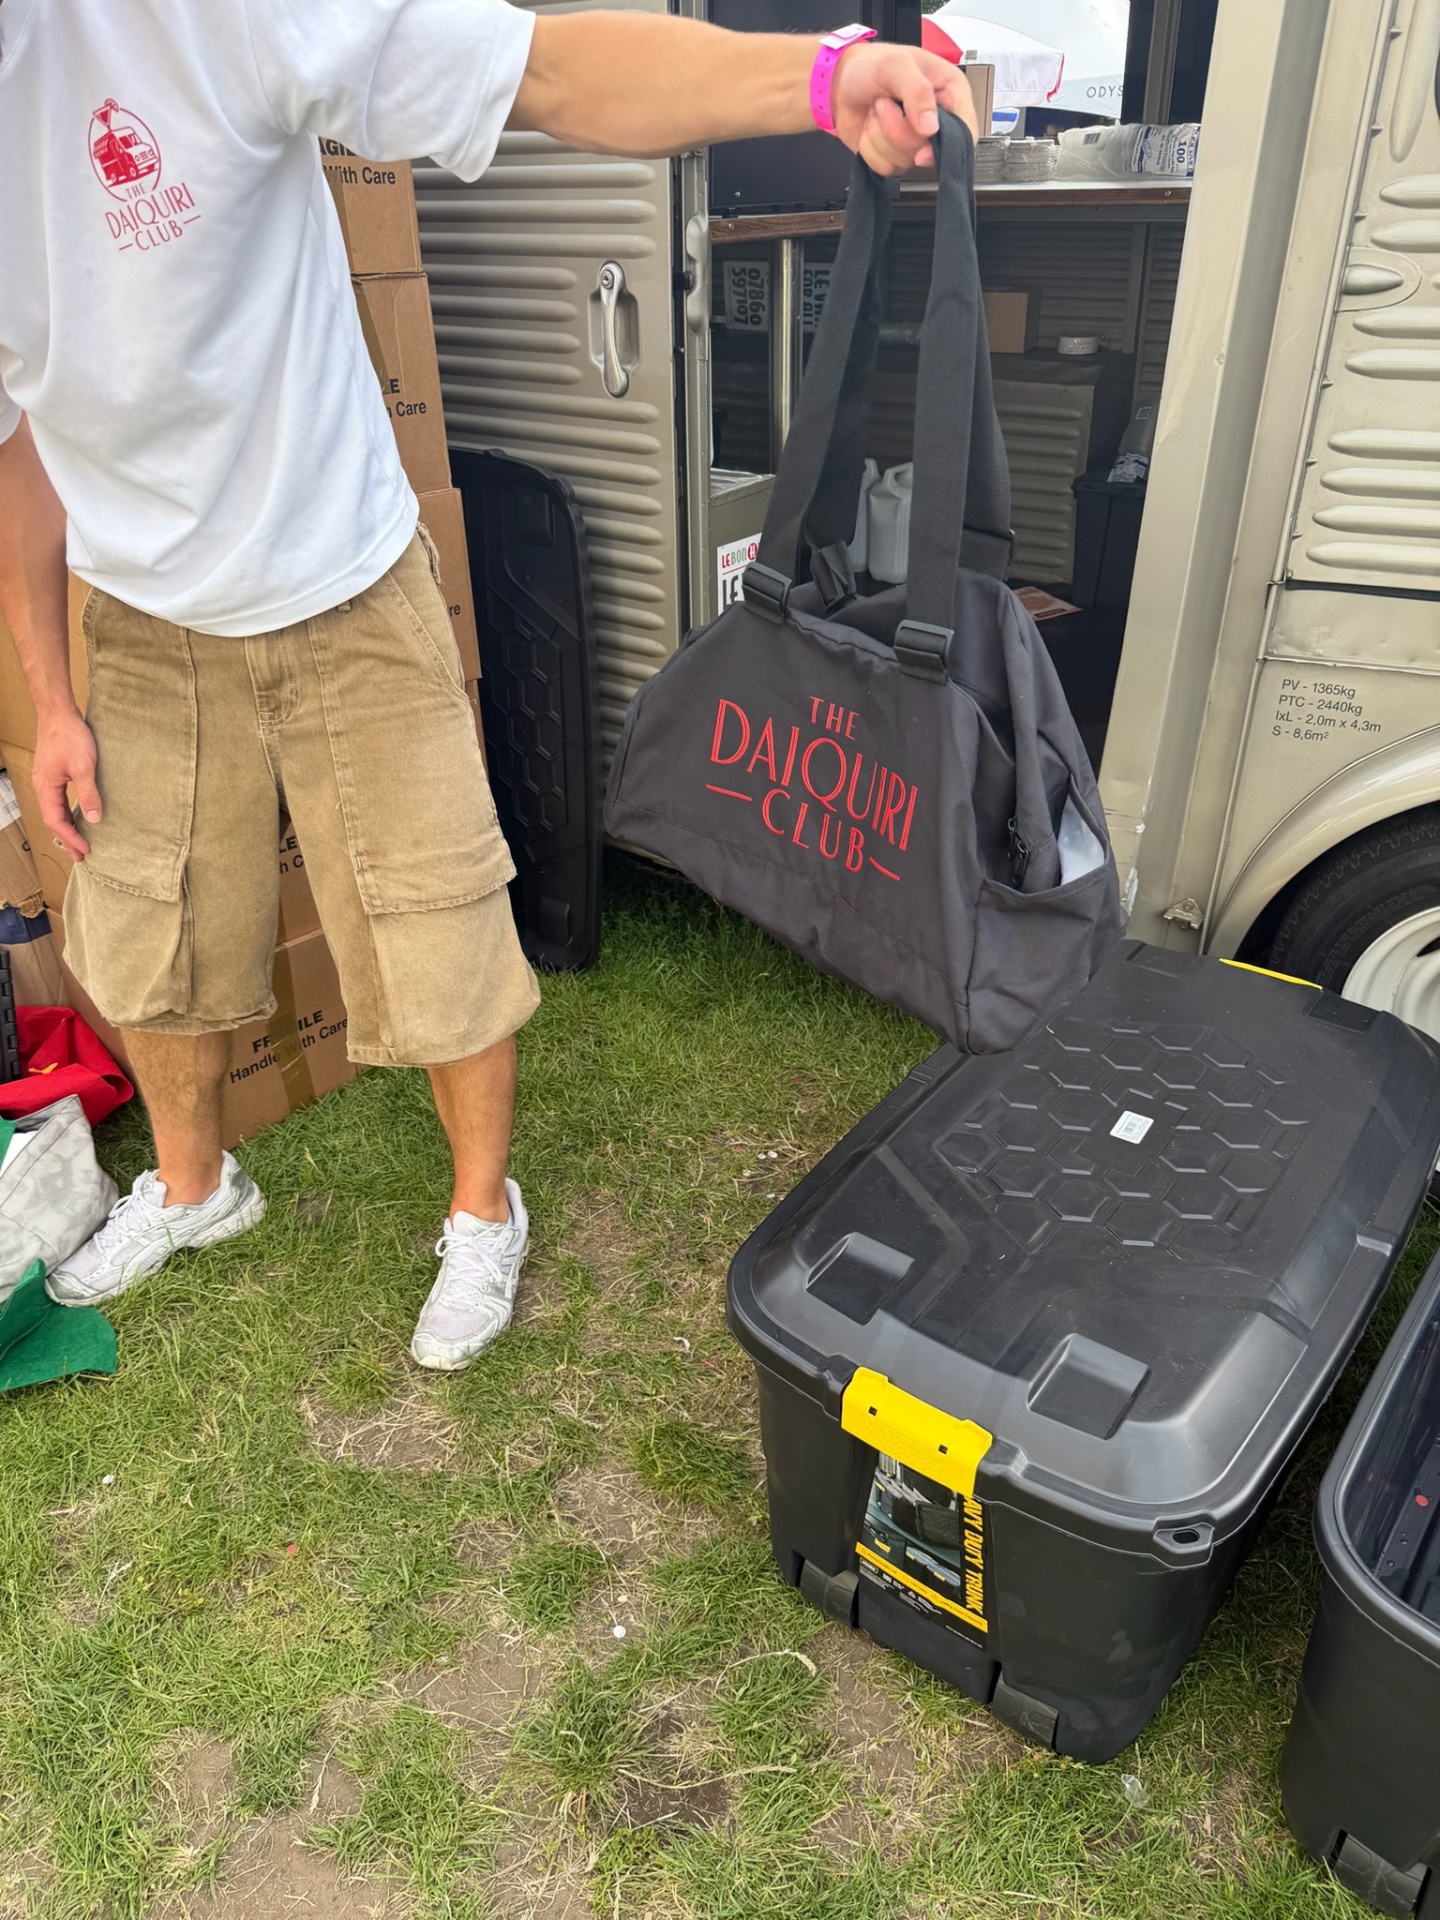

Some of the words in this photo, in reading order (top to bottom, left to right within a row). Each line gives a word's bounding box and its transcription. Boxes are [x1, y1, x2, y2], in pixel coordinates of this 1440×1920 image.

[1176, 140, 1187, 163] 100
[125, 182, 147, 200] THE
[362, 166, 396, 185] Care
[105, 182, 196, 239] DAIQUIRI
[135, 219, 183, 251] CLUB
[732, 267, 749, 325] 597107
[748, 267, 766, 326] 07860
[395, 400, 427, 417] Care
[1278, 694, 1306, 708] PTC
[1316, 699, 1363, 717] 2440kg
[1281, 679, 1301, 691] PV
[1312, 682, 1356, 700] 1365kg
[810, 695, 859, 741] THE
[1272, 725, 1282, 736] S
[1305, 713, 1336, 727] 2,0m
[1350, 719, 1382, 733] 4,3m
[710, 698, 919, 851] DAIQUIRI
[762, 788, 865, 873] CLUB
[229, 1053, 280, 1084] Handle
[319, 1018, 348, 1040] Care
[252, 1010, 324, 1054] FRILE
[963, 1529, 984, 1570] DUTY
[965, 1568, 984, 1615] TRUNK
